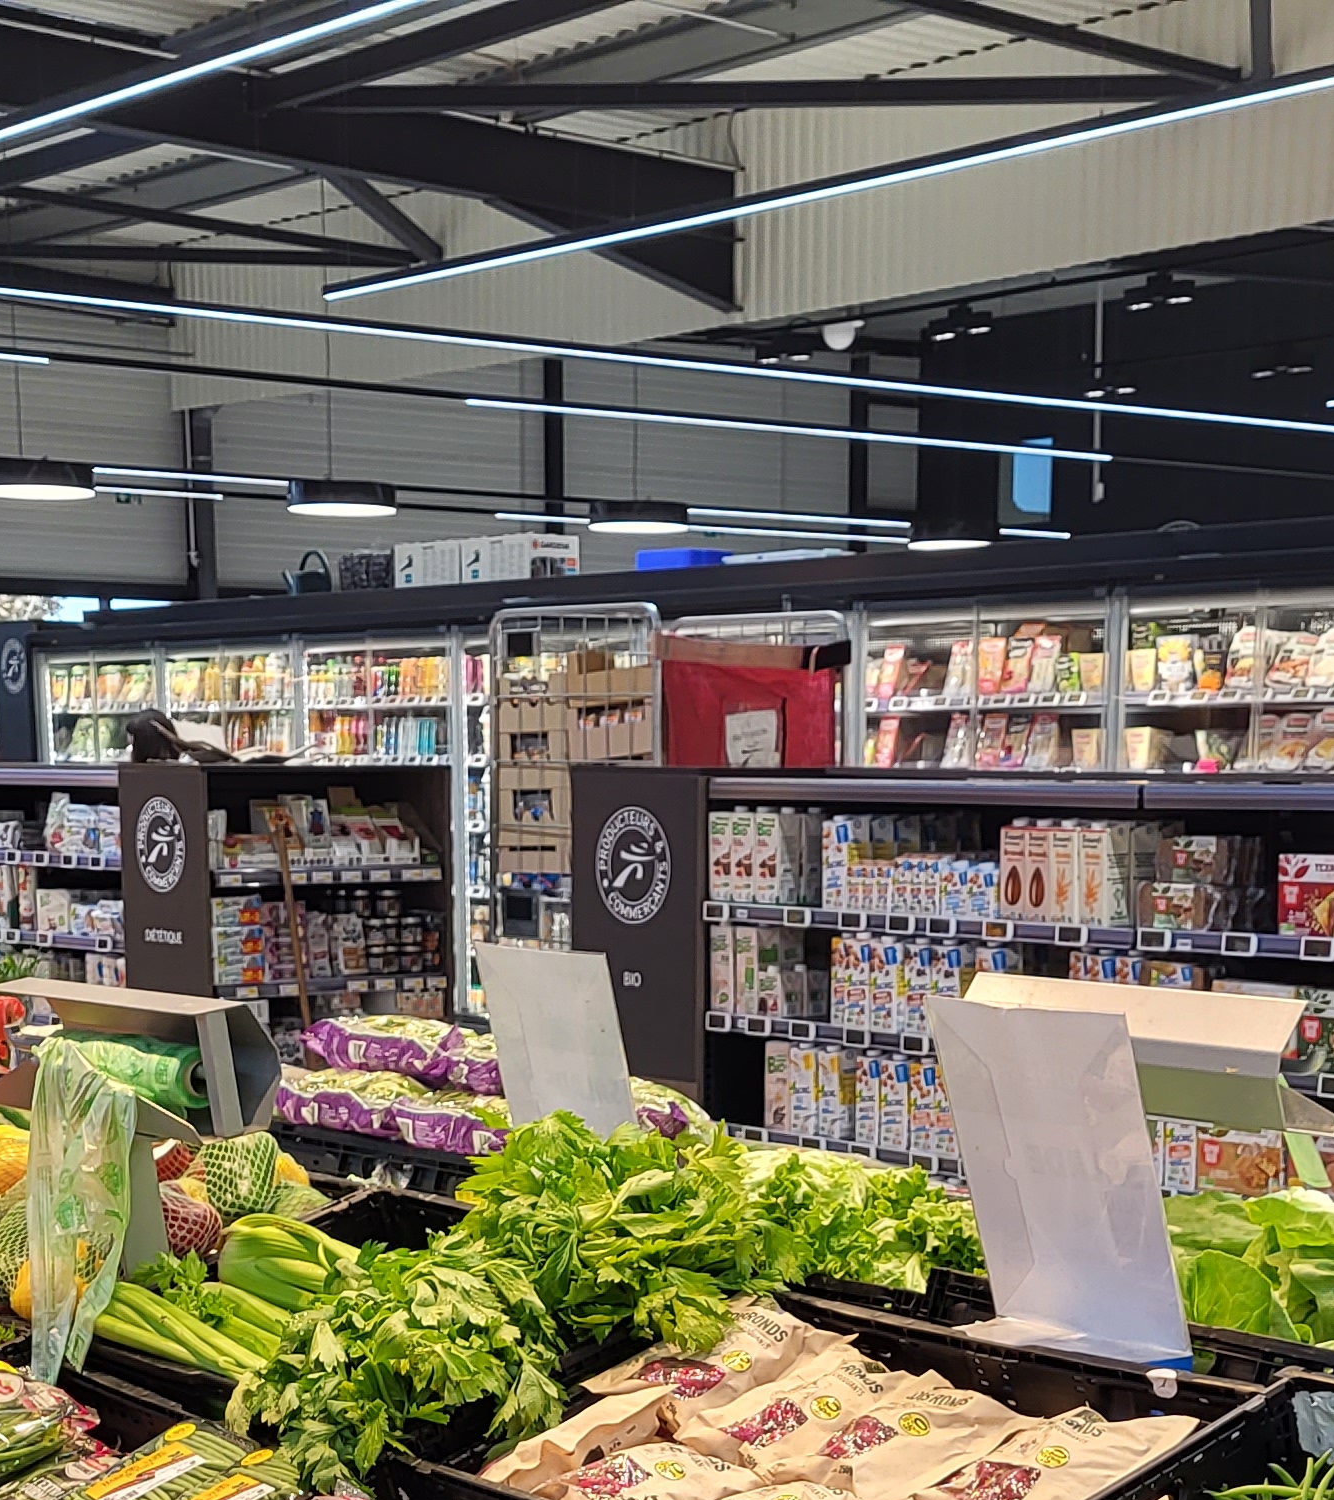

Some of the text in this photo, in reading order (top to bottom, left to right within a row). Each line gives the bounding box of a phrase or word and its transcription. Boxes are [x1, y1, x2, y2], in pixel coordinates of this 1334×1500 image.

[599, 811, 658, 871] PRODUCTEURS
[608, 861, 669, 920] COMMERÇANTS
[623, 971, 642, 987] BIO
